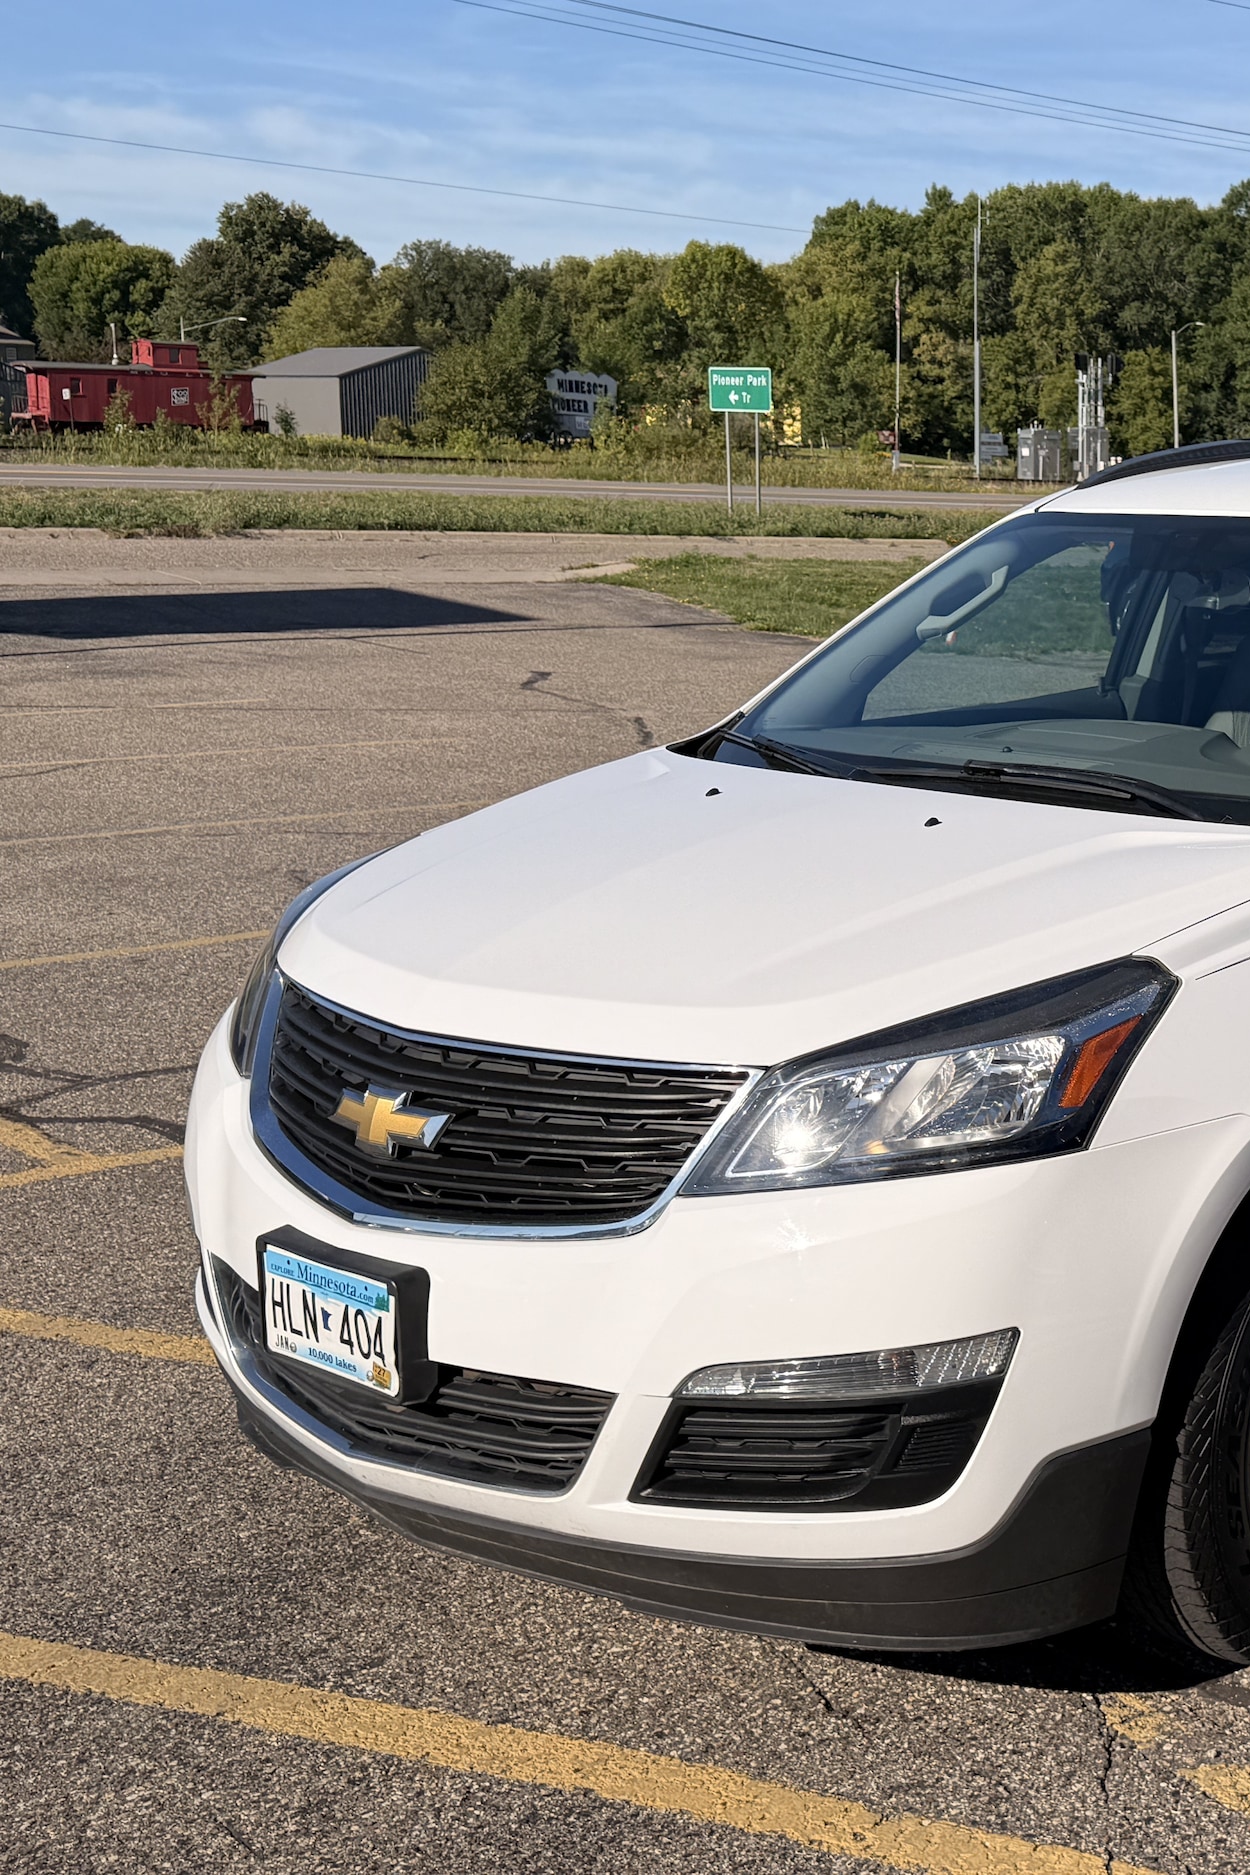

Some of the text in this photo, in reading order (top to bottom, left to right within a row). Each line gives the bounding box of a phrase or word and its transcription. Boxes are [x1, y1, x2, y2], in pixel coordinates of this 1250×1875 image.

[712, 373, 767, 387] Pioneer Park
[741, 391, 751, 403] Tr
[297, 1262, 374, 1304] Minnesota.com
[272, 1277, 386, 1367] HLN 404
[275, 1334, 290, 1351] JAN
[308, 1347, 357, 1373] 10,000 lakes
